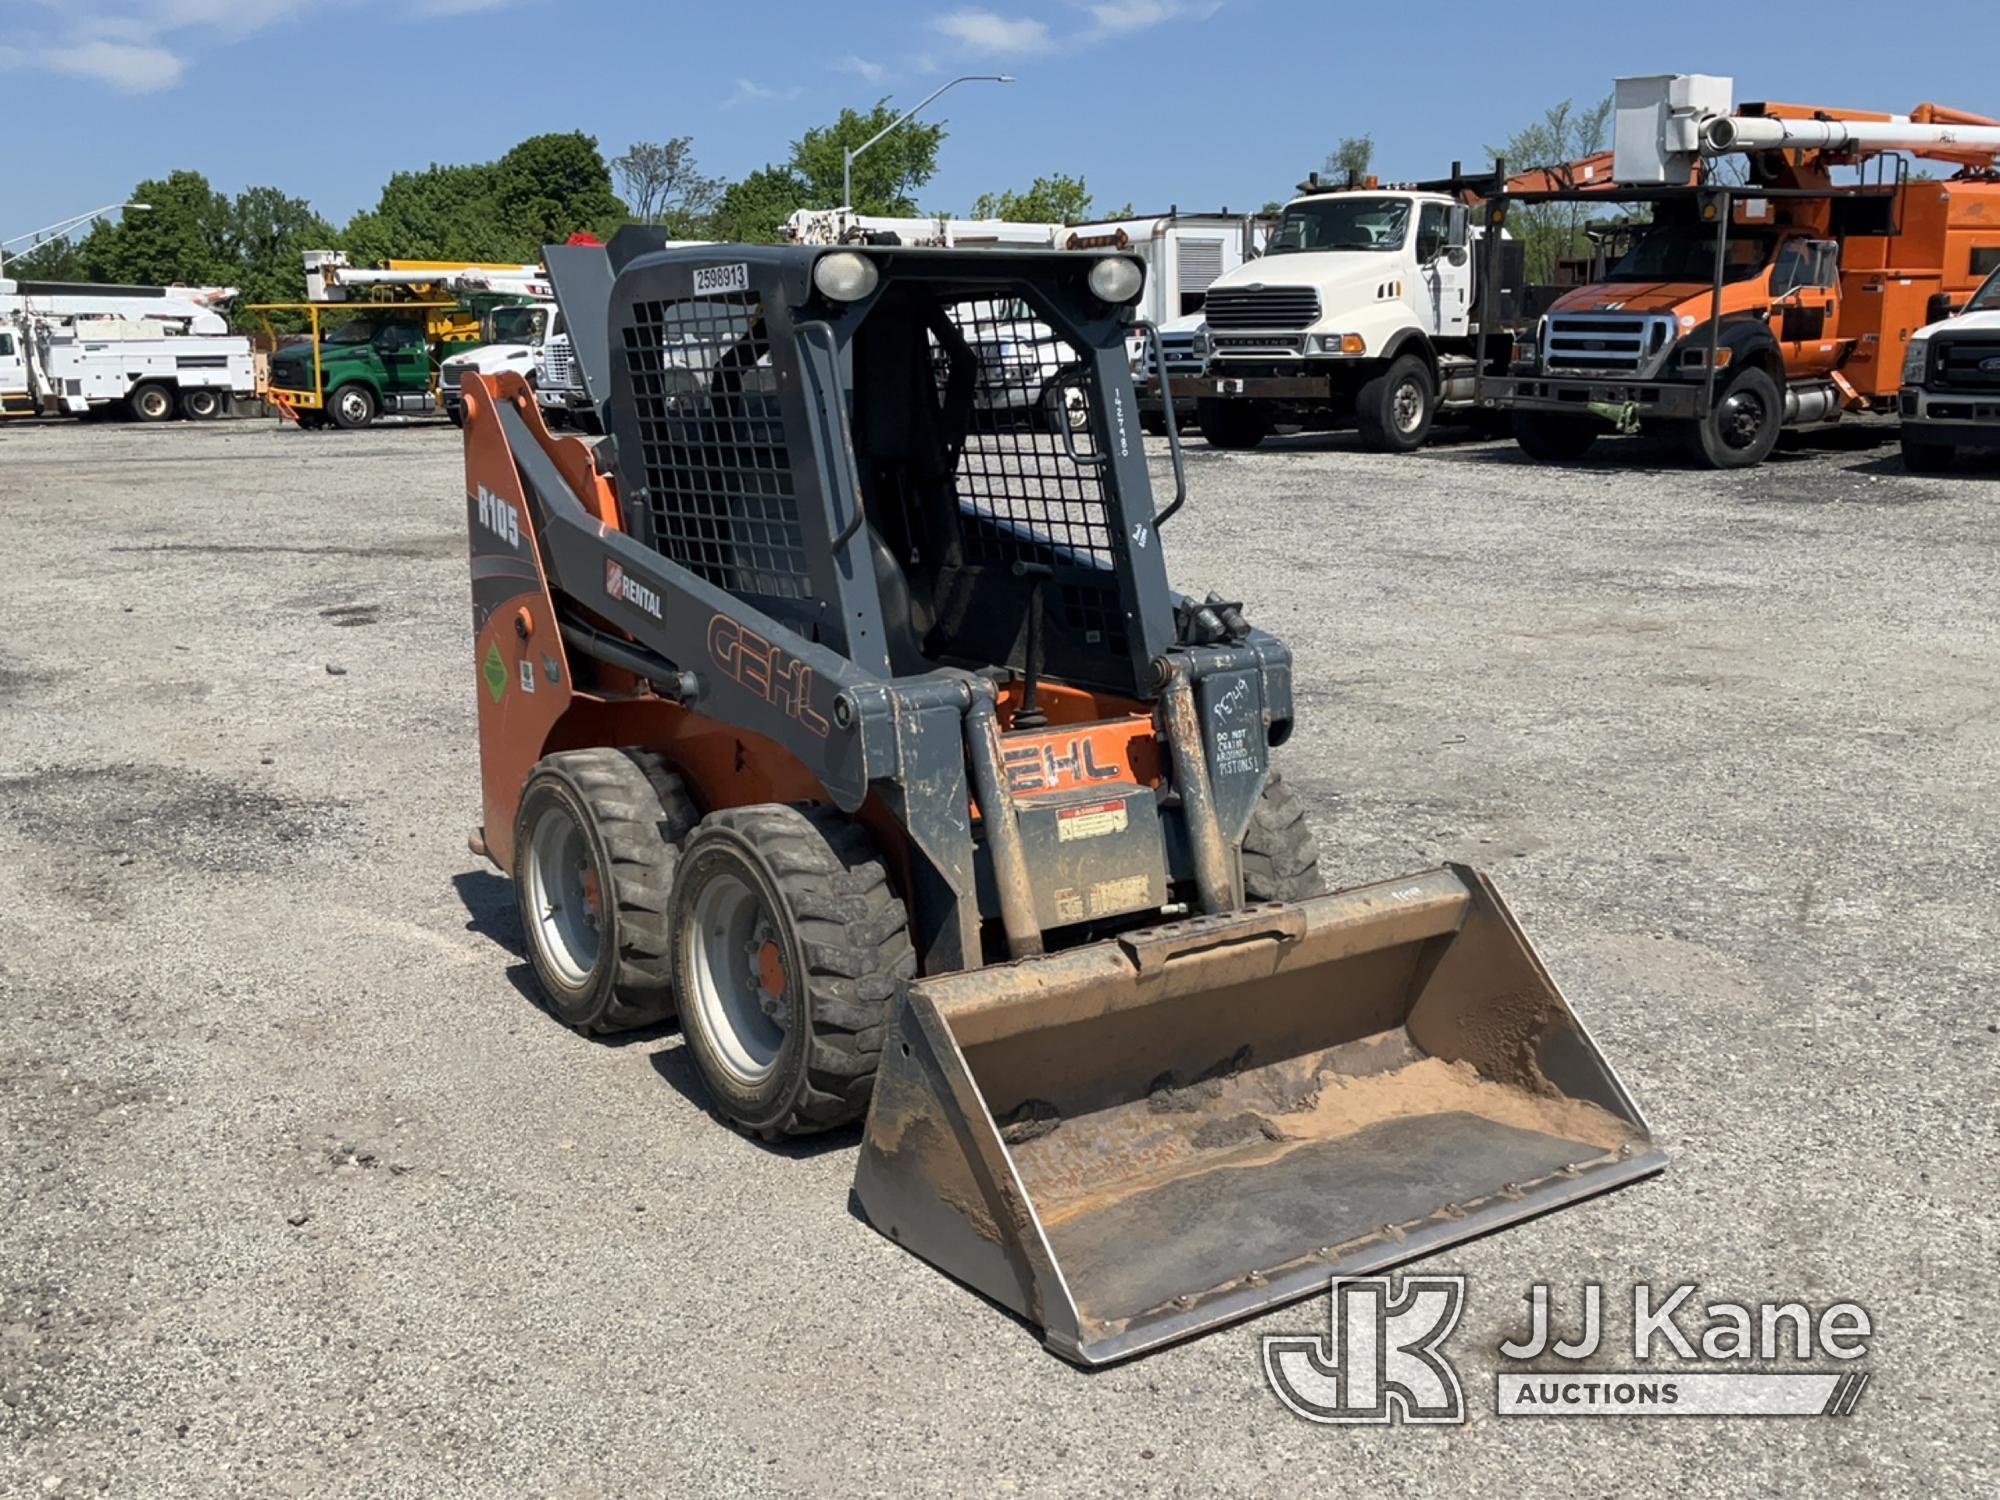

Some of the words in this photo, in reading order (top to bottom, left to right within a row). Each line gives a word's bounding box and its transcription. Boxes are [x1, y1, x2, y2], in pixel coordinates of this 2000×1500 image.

[697, 265, 746, 290] 2598913
[477, 484, 519, 550] R105
[622, 575, 663, 620] RENTAL
[707, 613, 831, 738] GEHL
[1001, 735, 1121, 791] EHL
